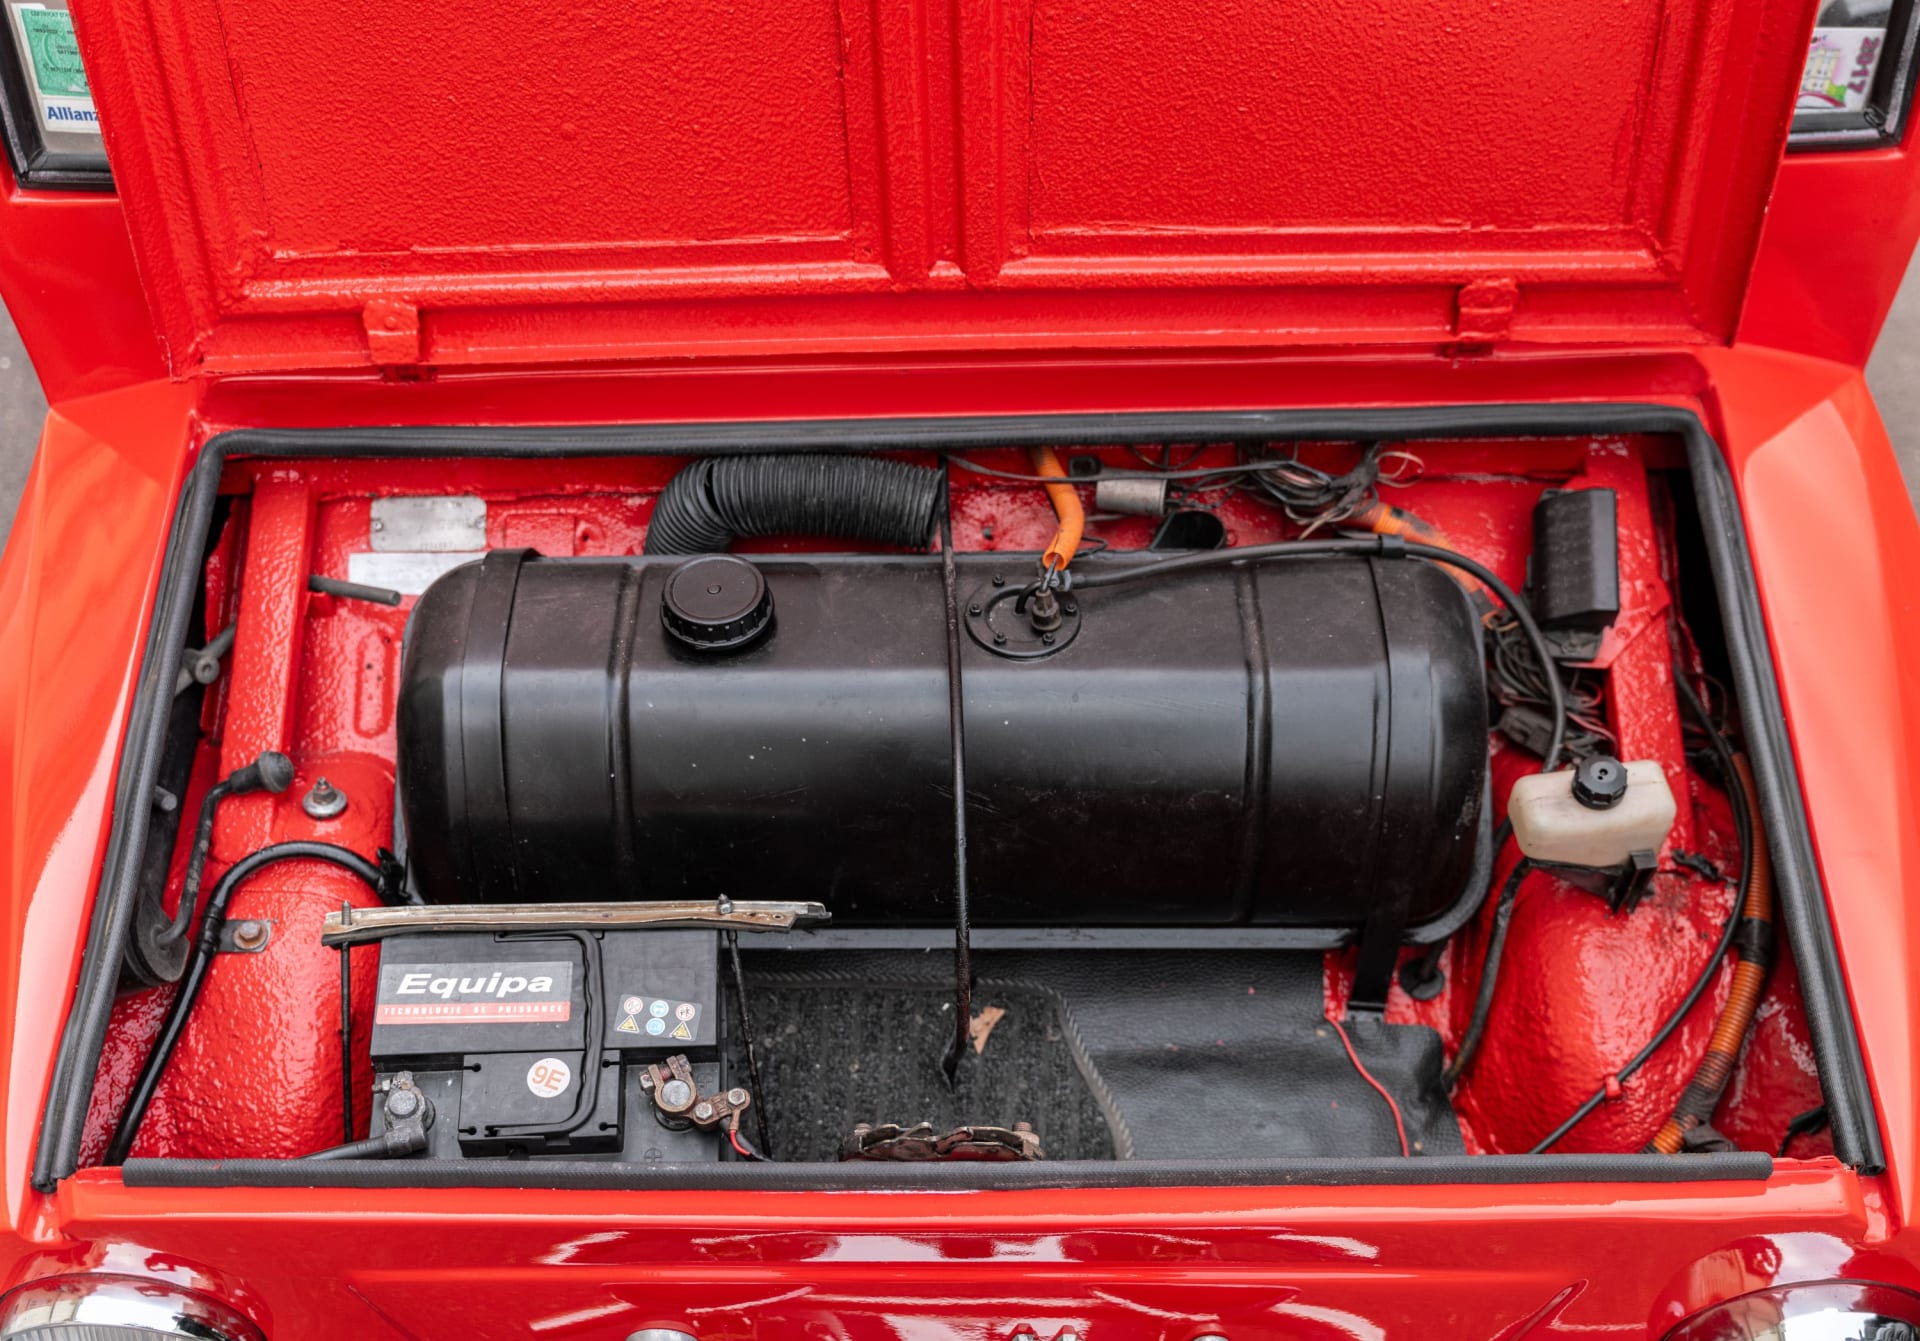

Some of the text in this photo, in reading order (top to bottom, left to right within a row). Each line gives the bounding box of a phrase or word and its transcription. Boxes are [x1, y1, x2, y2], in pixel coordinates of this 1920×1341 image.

[1847, 36, 1880, 94] 2017
[396, 972, 553, 999] Equipa
[384, 1005, 563, 1015] TECHNOLOGIE DE PUISSANCE
[532, 1065, 566, 1091] 9E
